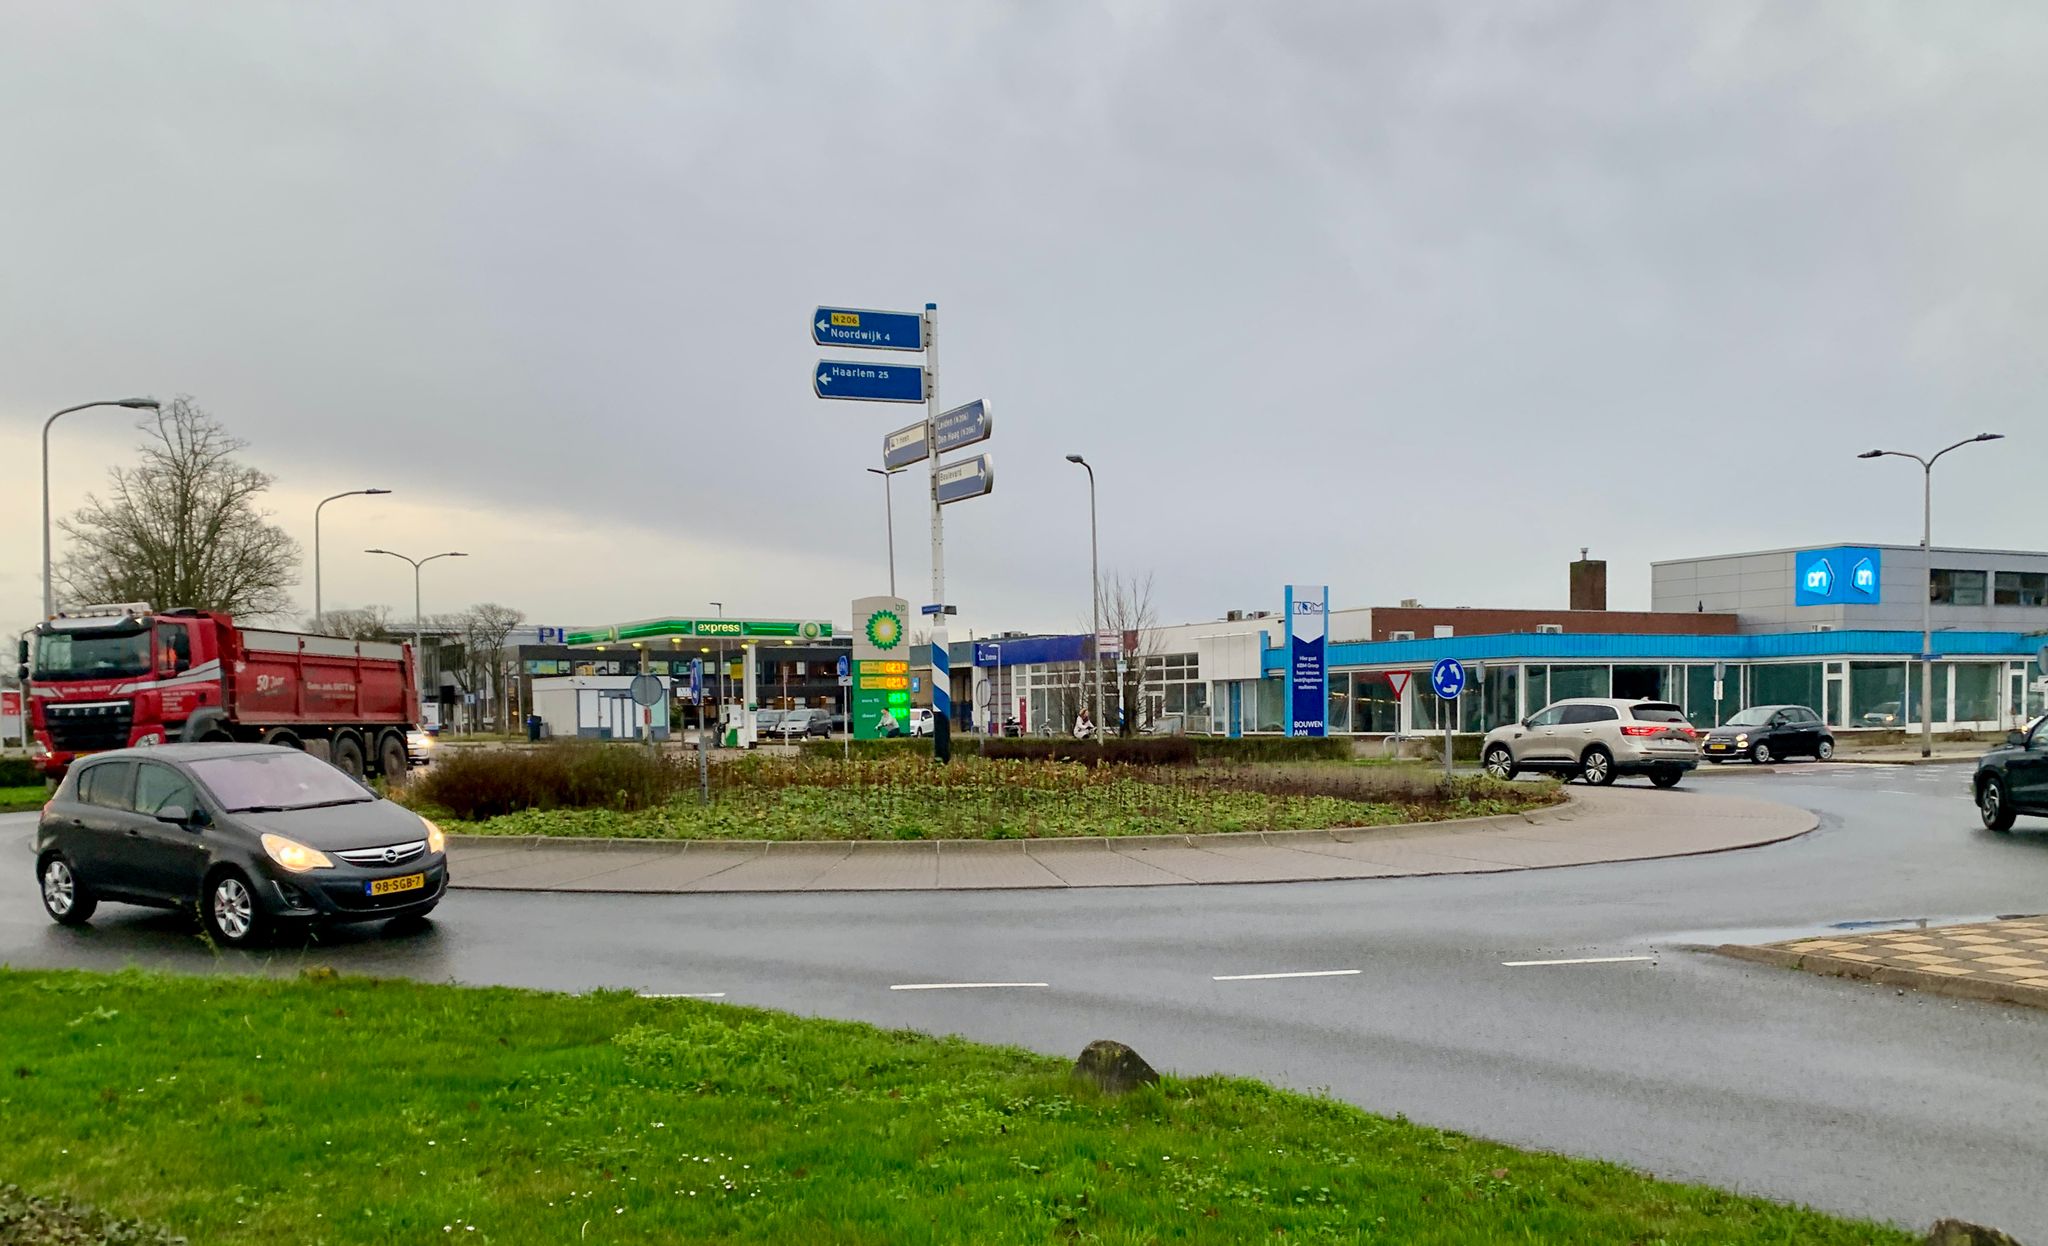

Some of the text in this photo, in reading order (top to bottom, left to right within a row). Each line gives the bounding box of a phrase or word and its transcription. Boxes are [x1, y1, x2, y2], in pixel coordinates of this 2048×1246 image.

[831, 329, 890, 342] Noordwijk 4
[832, 367, 889, 379] Haarlem 25
[895, 603, 906, 612] bp
[1293, 601, 1323, 615] KBM
[697, 622, 740, 633] express
[54, 706, 121, 716] TATRA
[375, 876, 420, 893] 98-SGB-7
